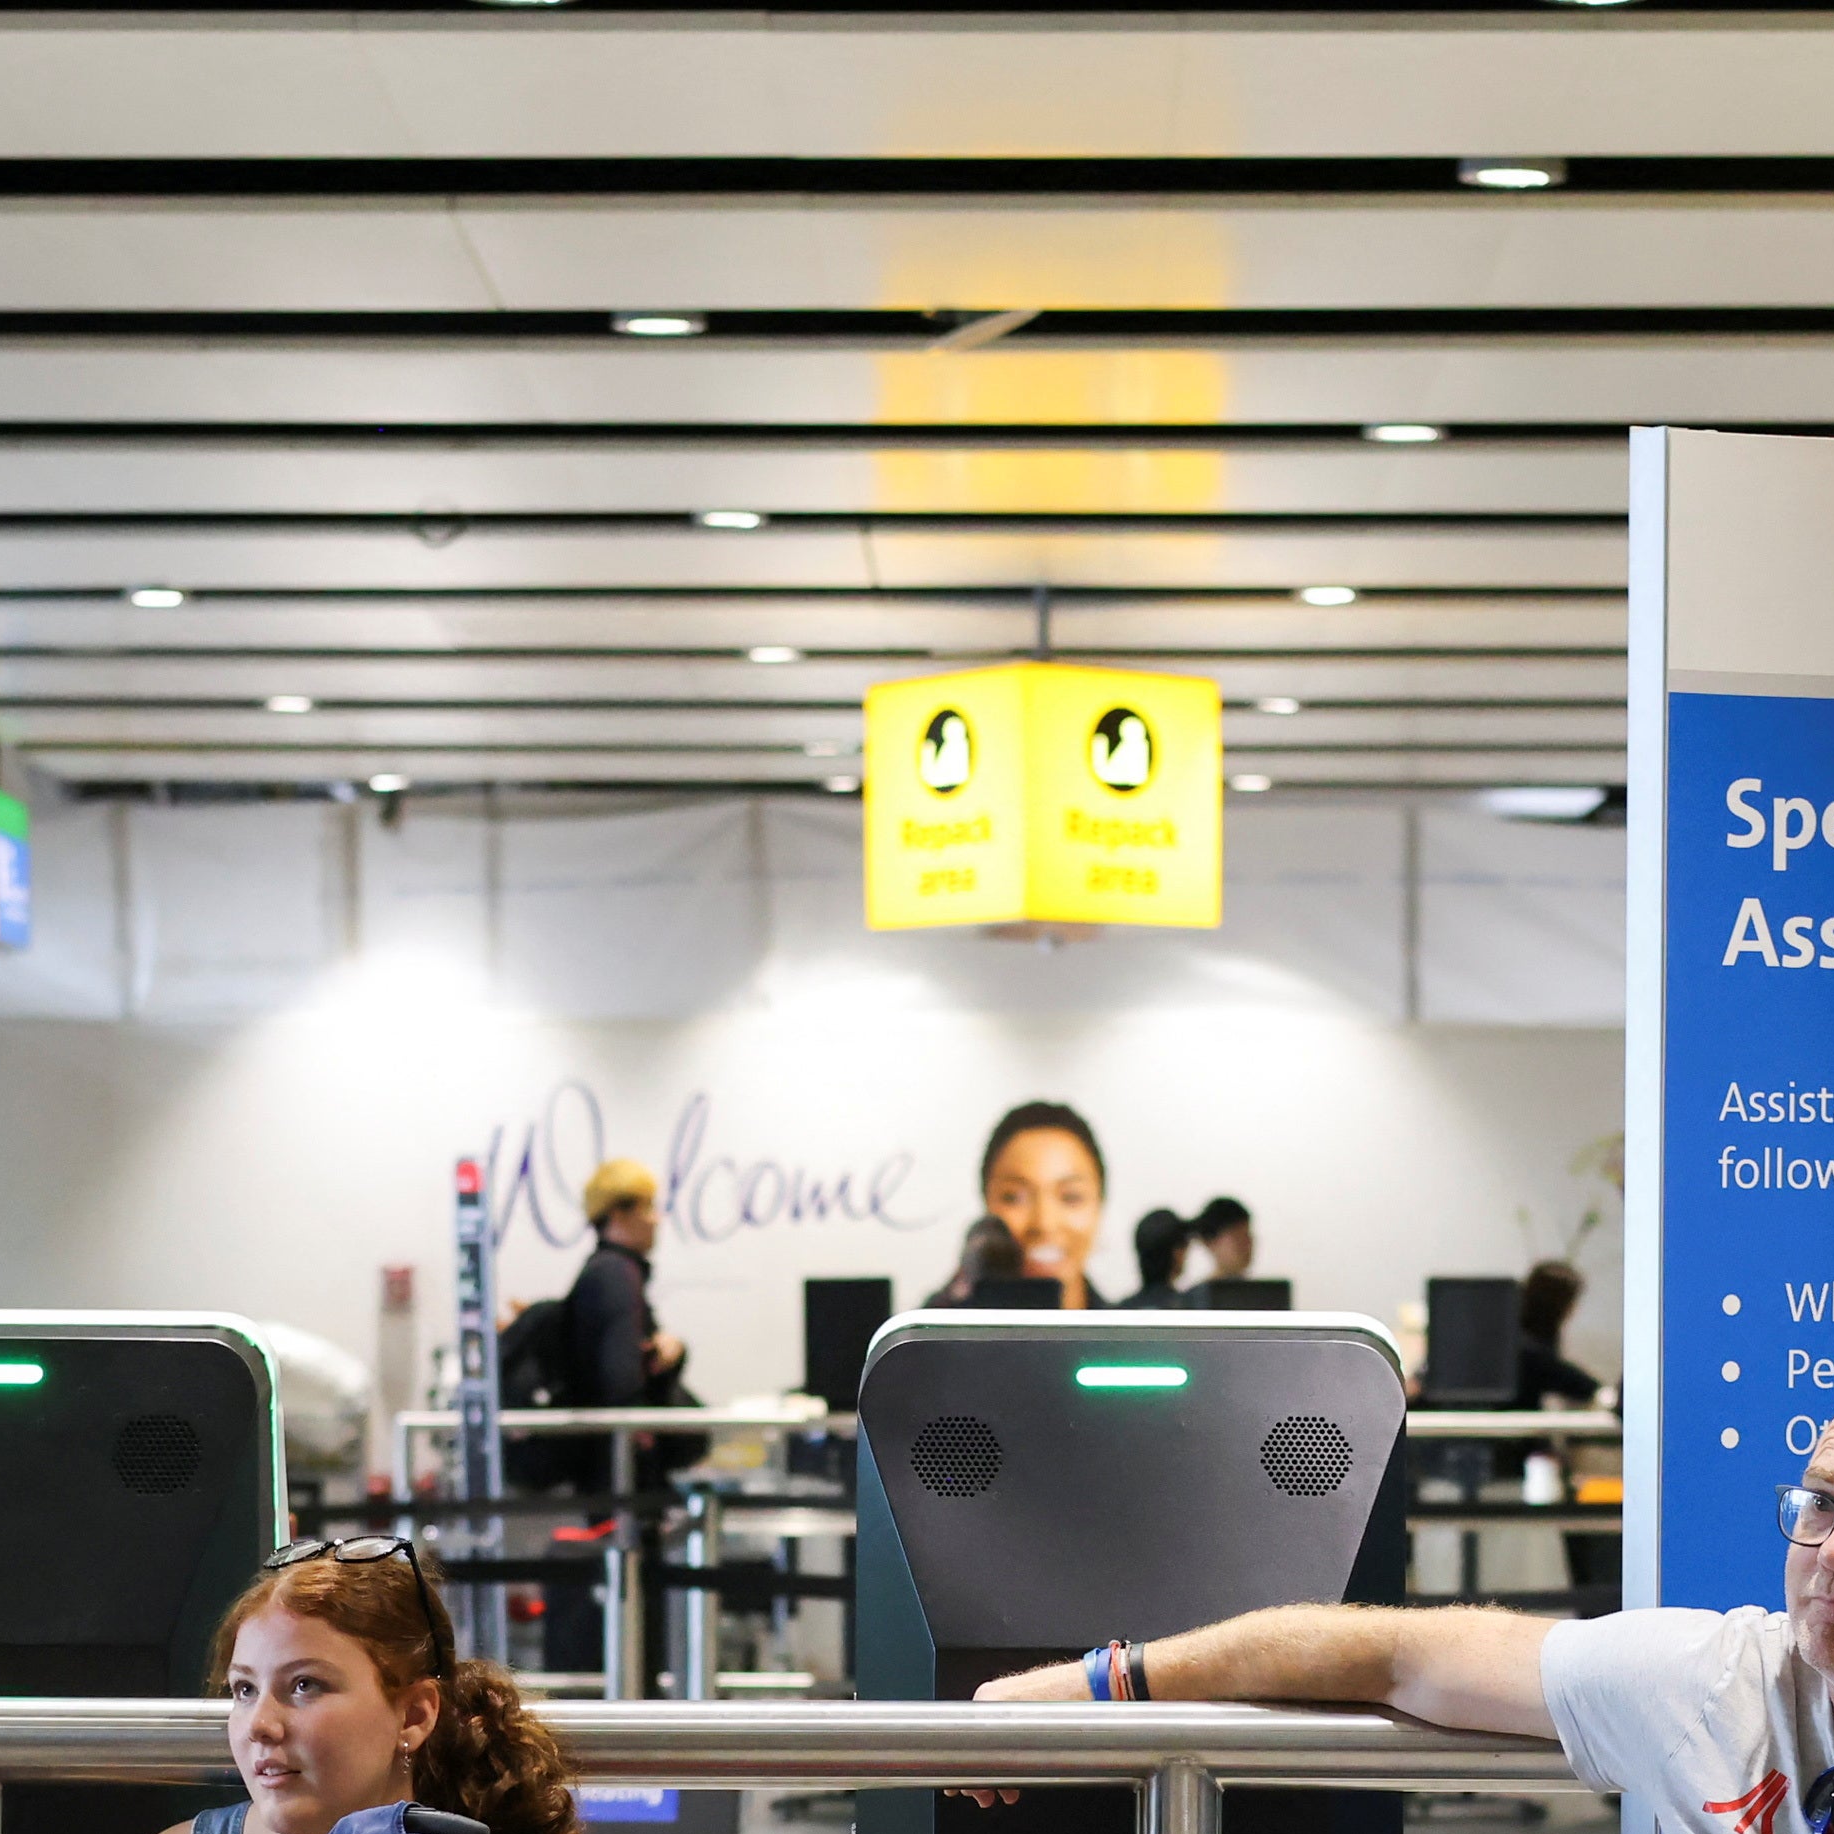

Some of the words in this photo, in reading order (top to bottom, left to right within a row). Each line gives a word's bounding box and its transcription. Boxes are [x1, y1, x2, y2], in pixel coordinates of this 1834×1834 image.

[1063, 809, 1177, 854] Repack
[1087, 864, 1158, 895] area
[486, 1080, 940, 1250] Wlcome
